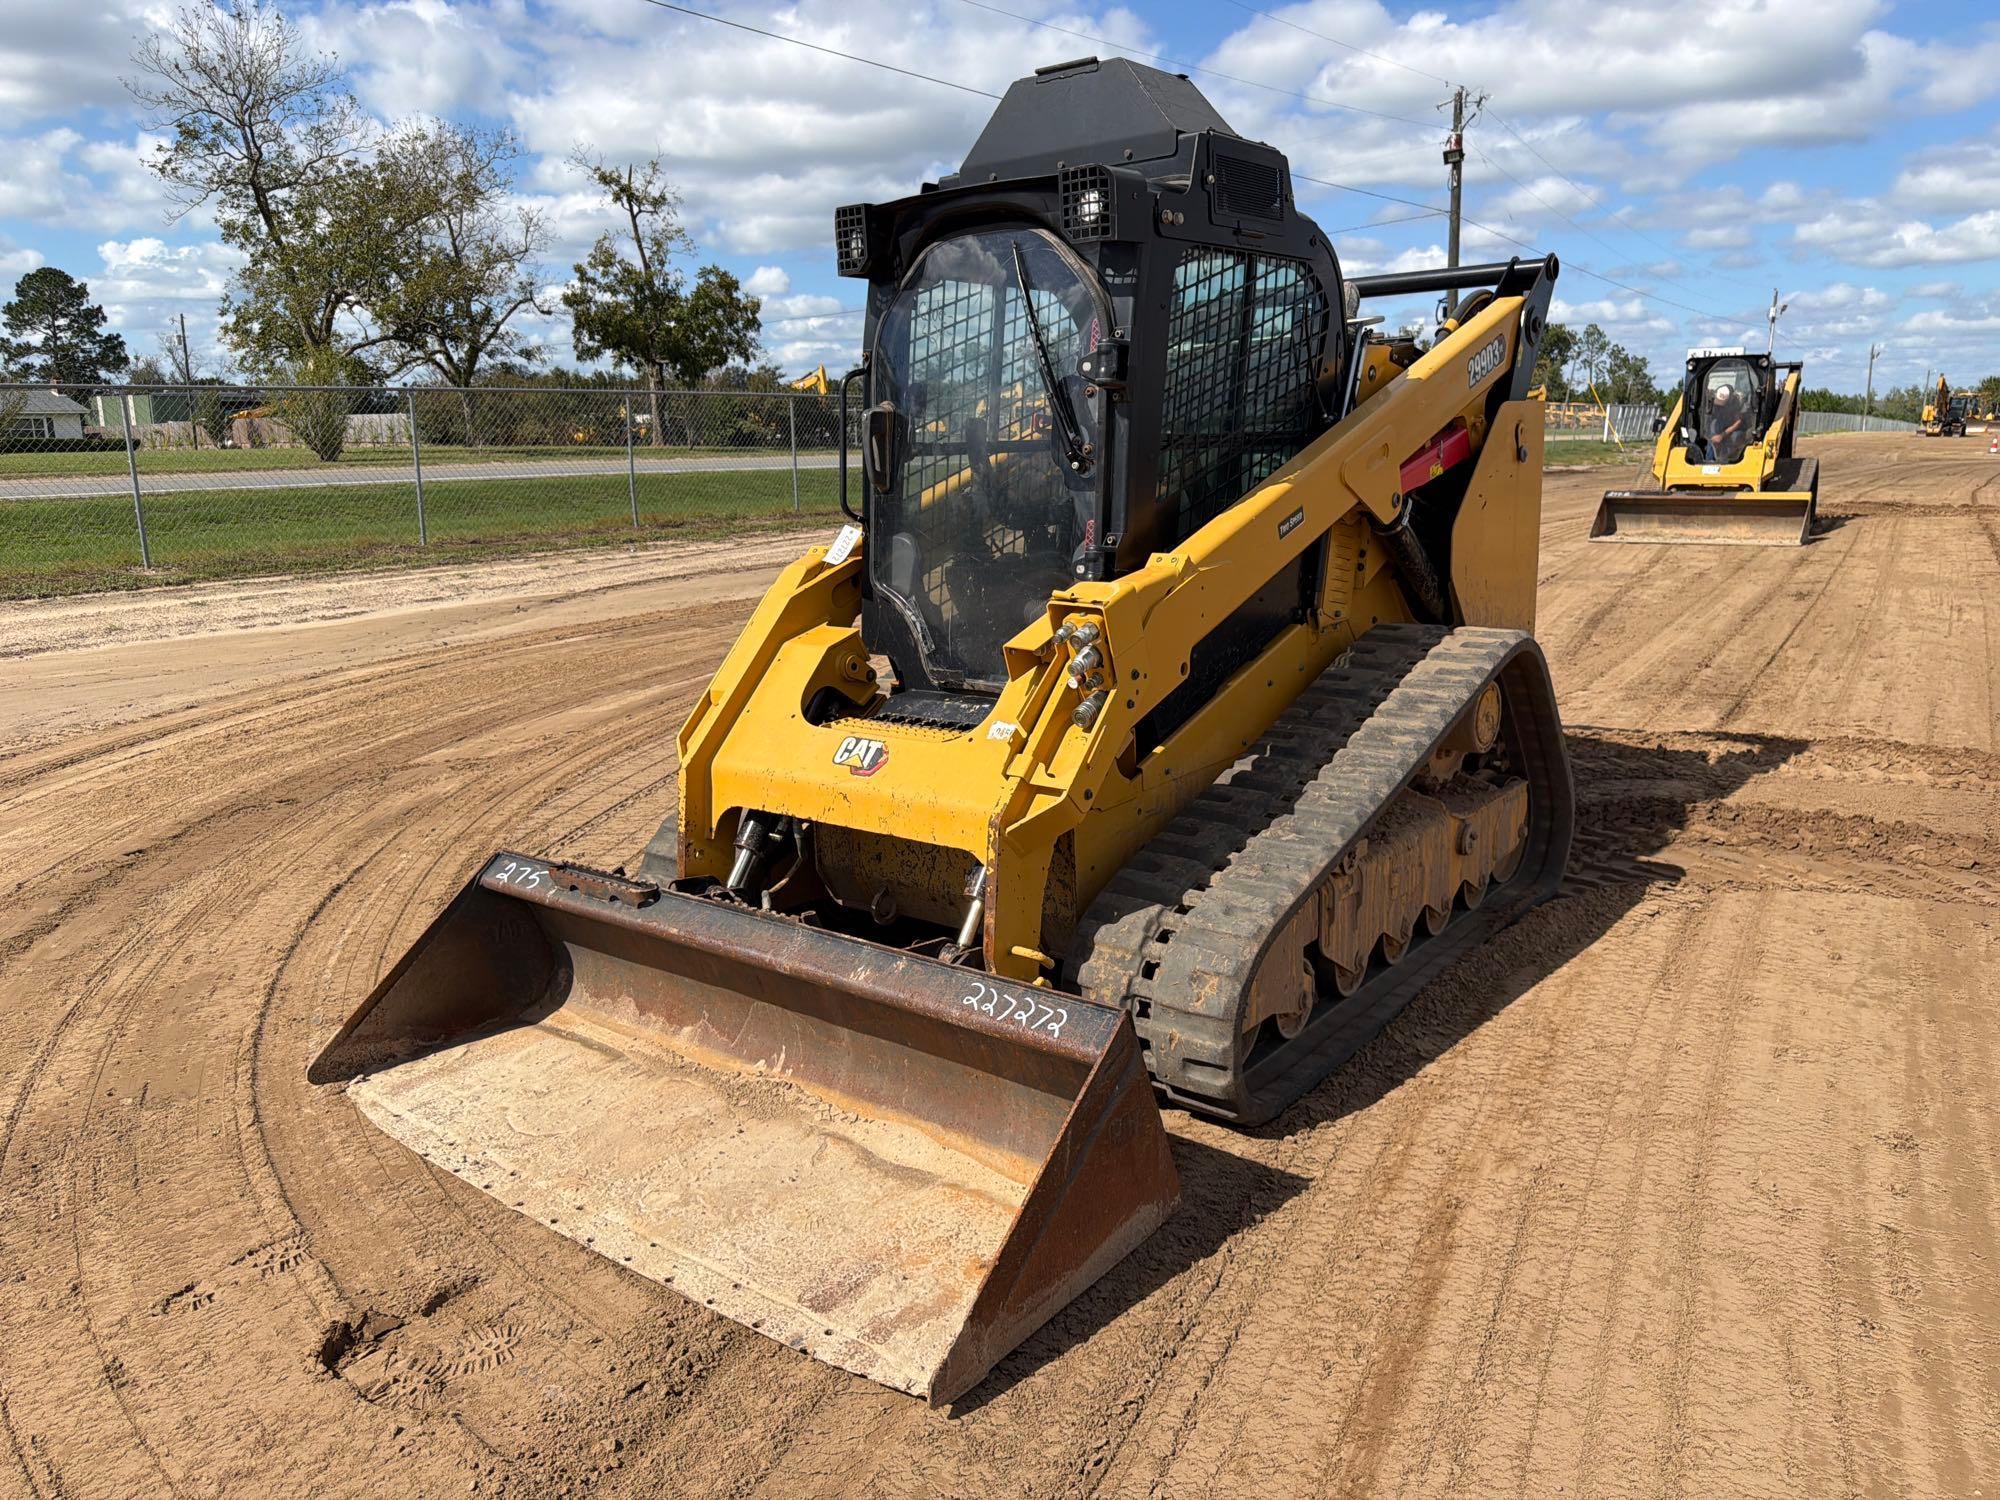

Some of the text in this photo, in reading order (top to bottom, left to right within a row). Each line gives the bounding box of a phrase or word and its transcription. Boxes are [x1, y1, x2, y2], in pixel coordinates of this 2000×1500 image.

[1468, 339, 1500, 387] 299D3
[833, 736, 884, 769] CAT
[495, 861, 550, 890] 275
[962, 982, 1068, 1039] 227272
